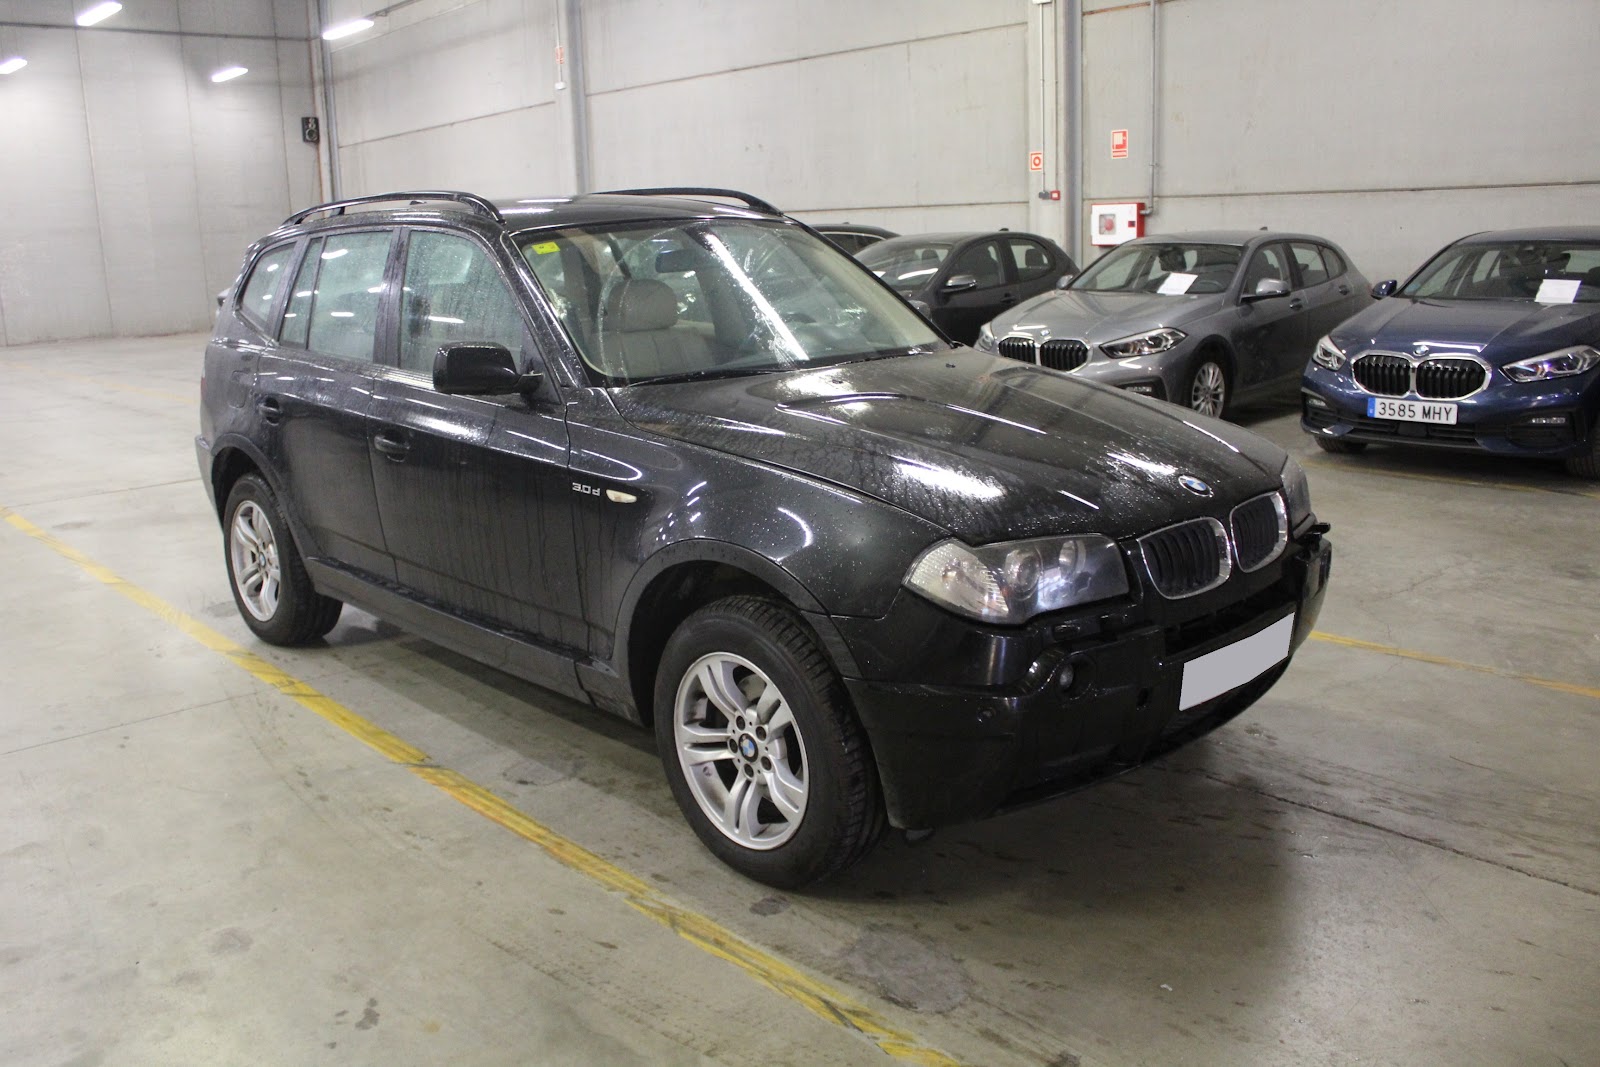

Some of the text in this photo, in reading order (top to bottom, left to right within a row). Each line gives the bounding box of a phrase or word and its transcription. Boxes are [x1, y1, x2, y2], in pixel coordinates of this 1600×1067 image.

[1378, 402, 1453, 421] 3585 MHY
[572, 482, 601, 497] 3.0d
